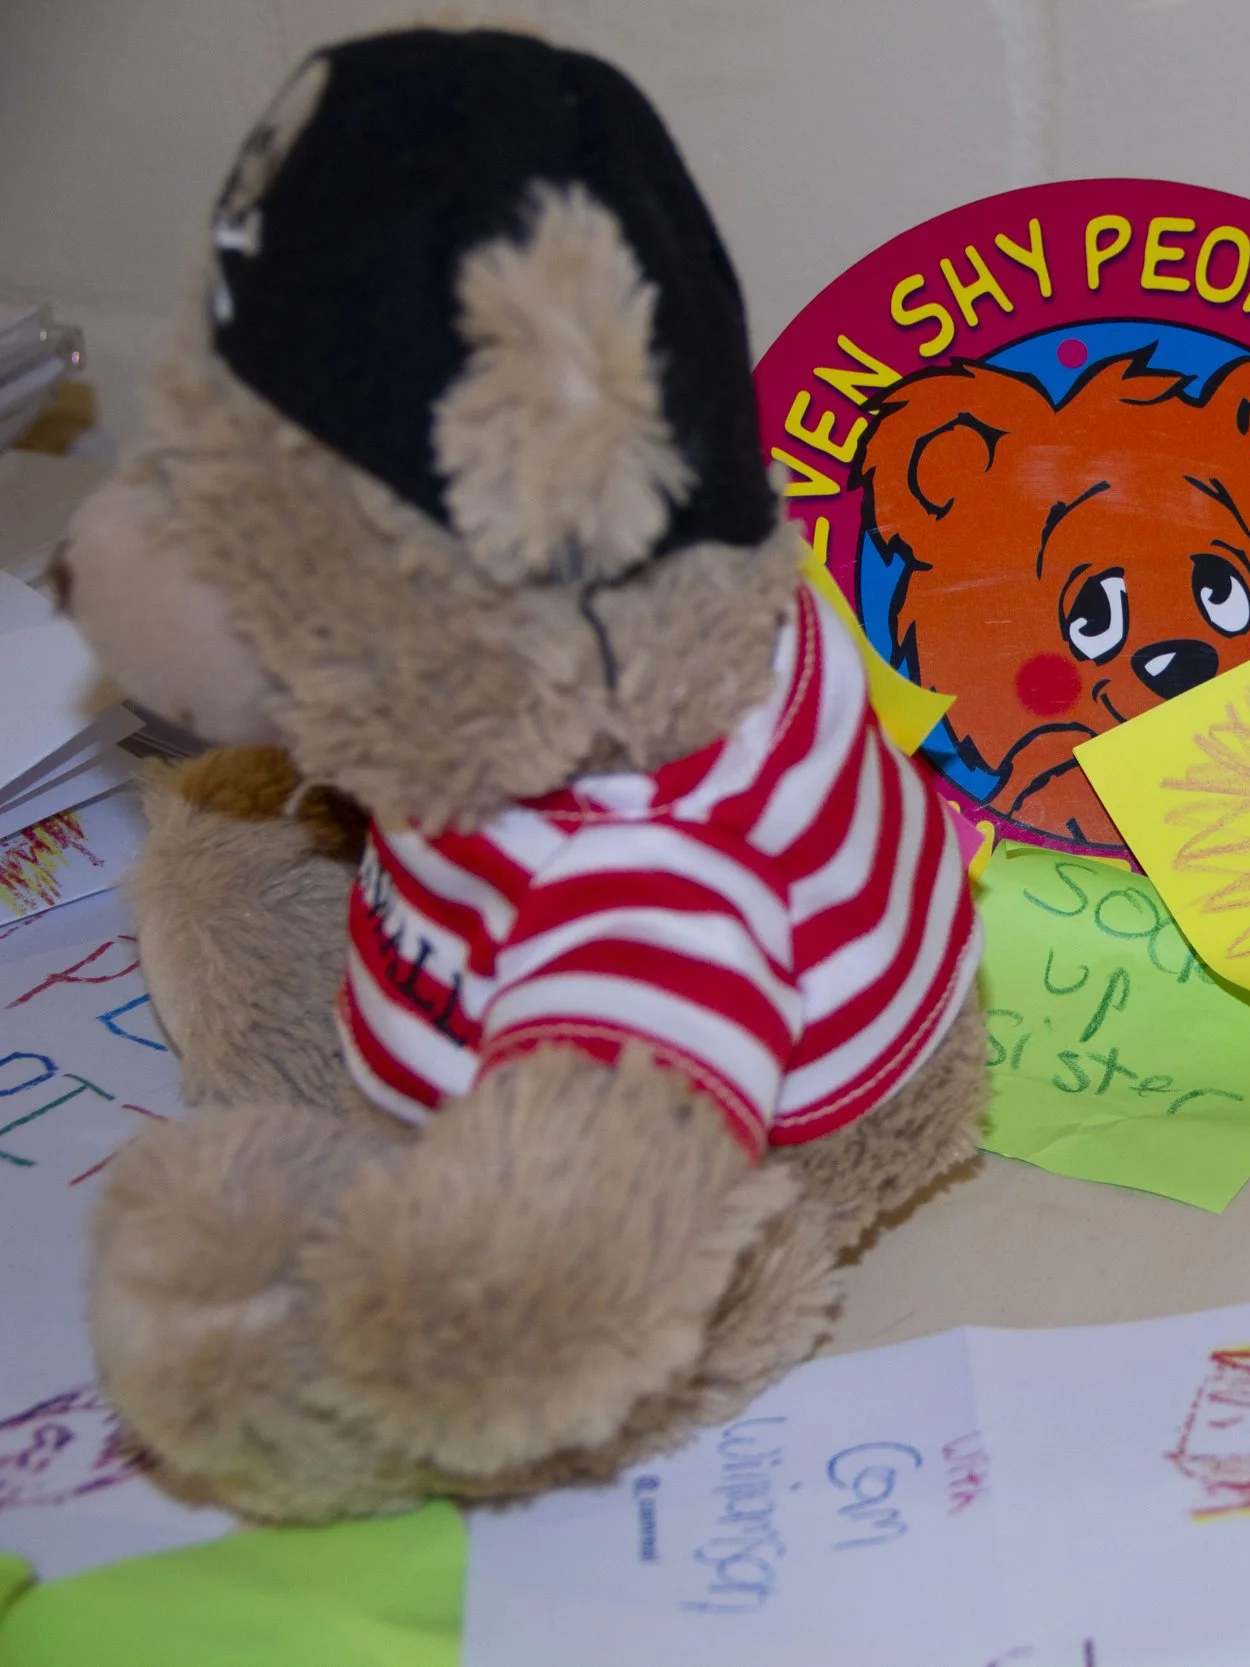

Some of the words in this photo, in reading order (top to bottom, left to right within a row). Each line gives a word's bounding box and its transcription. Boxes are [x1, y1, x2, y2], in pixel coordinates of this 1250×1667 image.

[771, 335, 903, 564] VEN
[890, 218, 1053, 358] SHY
[1044, 948, 1131, 1042] up
